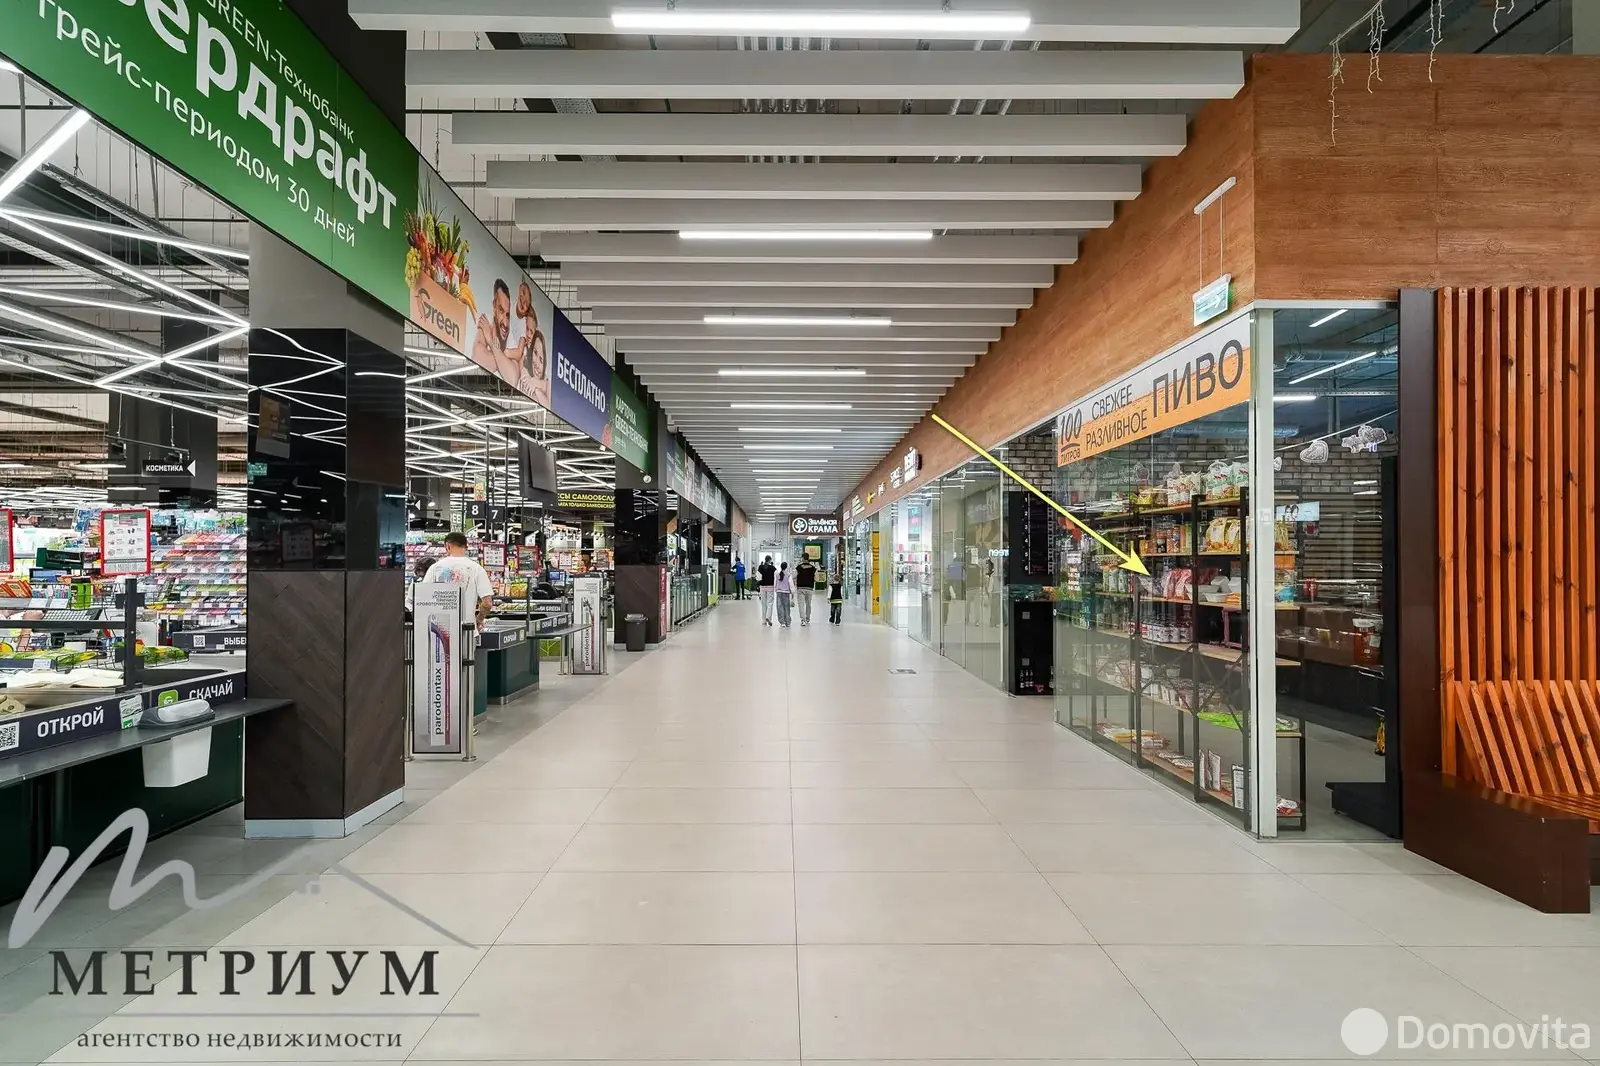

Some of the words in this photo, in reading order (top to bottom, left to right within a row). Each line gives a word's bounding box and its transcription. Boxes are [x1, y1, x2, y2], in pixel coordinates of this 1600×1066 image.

[117, 0, 397, 229] ердрафт
[287, 177, 309, 212] 30
[314, 206, 355, 247] дней
[416, 287, 459, 343] Green
[557, 352, 606, 413] БЕСПЛАТНО
[1153, 340, 1243, 418] ПИВО
[1091, 384, 1132, 420] СВЕЖЕЕ
[1060, 408, 1082, 445] 100
[1086, 409, 1147, 450] РАЗЛИВНОЕ
[1060, 449, 1080, 464] ЛИТРОВ
[472, 505, 478, 515] 8
[492, 510, 498, 519] 7
[189, 679, 233, 700] СКАЧАЙ
[434, 668, 443, 735] parodontax
[37, 706, 104, 738] ОТКРОЙ
